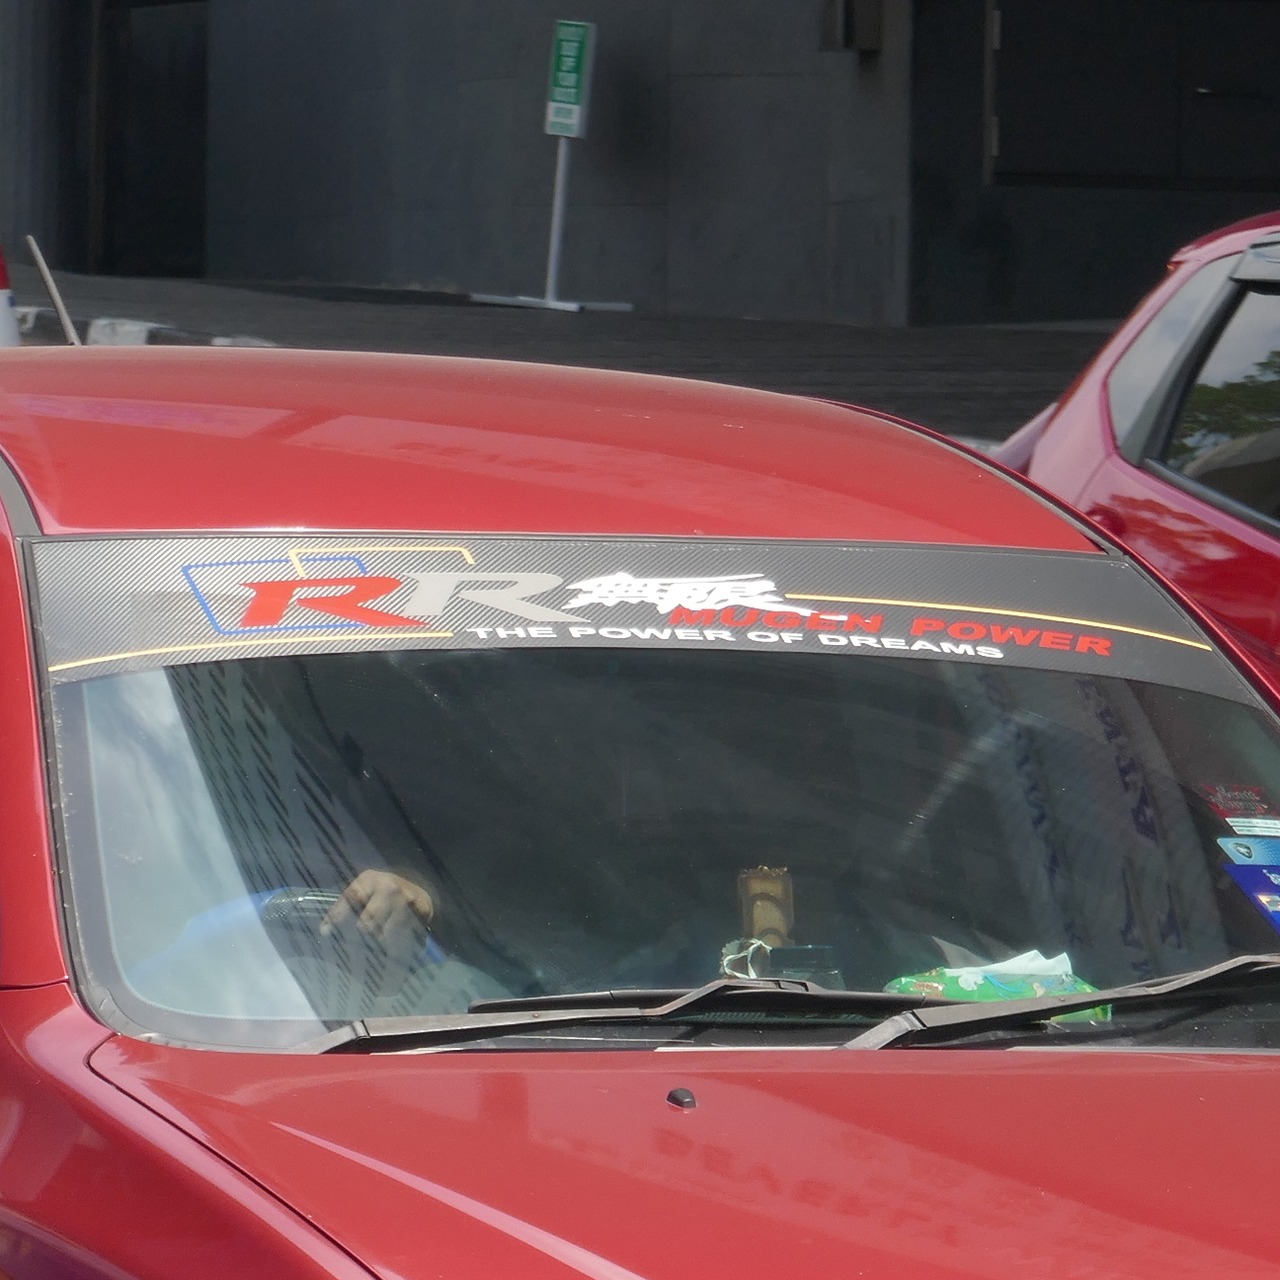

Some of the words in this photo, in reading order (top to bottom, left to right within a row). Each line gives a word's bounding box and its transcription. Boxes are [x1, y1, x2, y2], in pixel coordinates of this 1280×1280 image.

[465, 626, 557, 640] THE
[569, 627, 737, 642] POWER
[747, 630, 804, 644] OF
[818, 632, 1005, 659] DREAMS
[669, 606, 885, 633] MUGEN
[910, 617, 1113, 657] POWER
